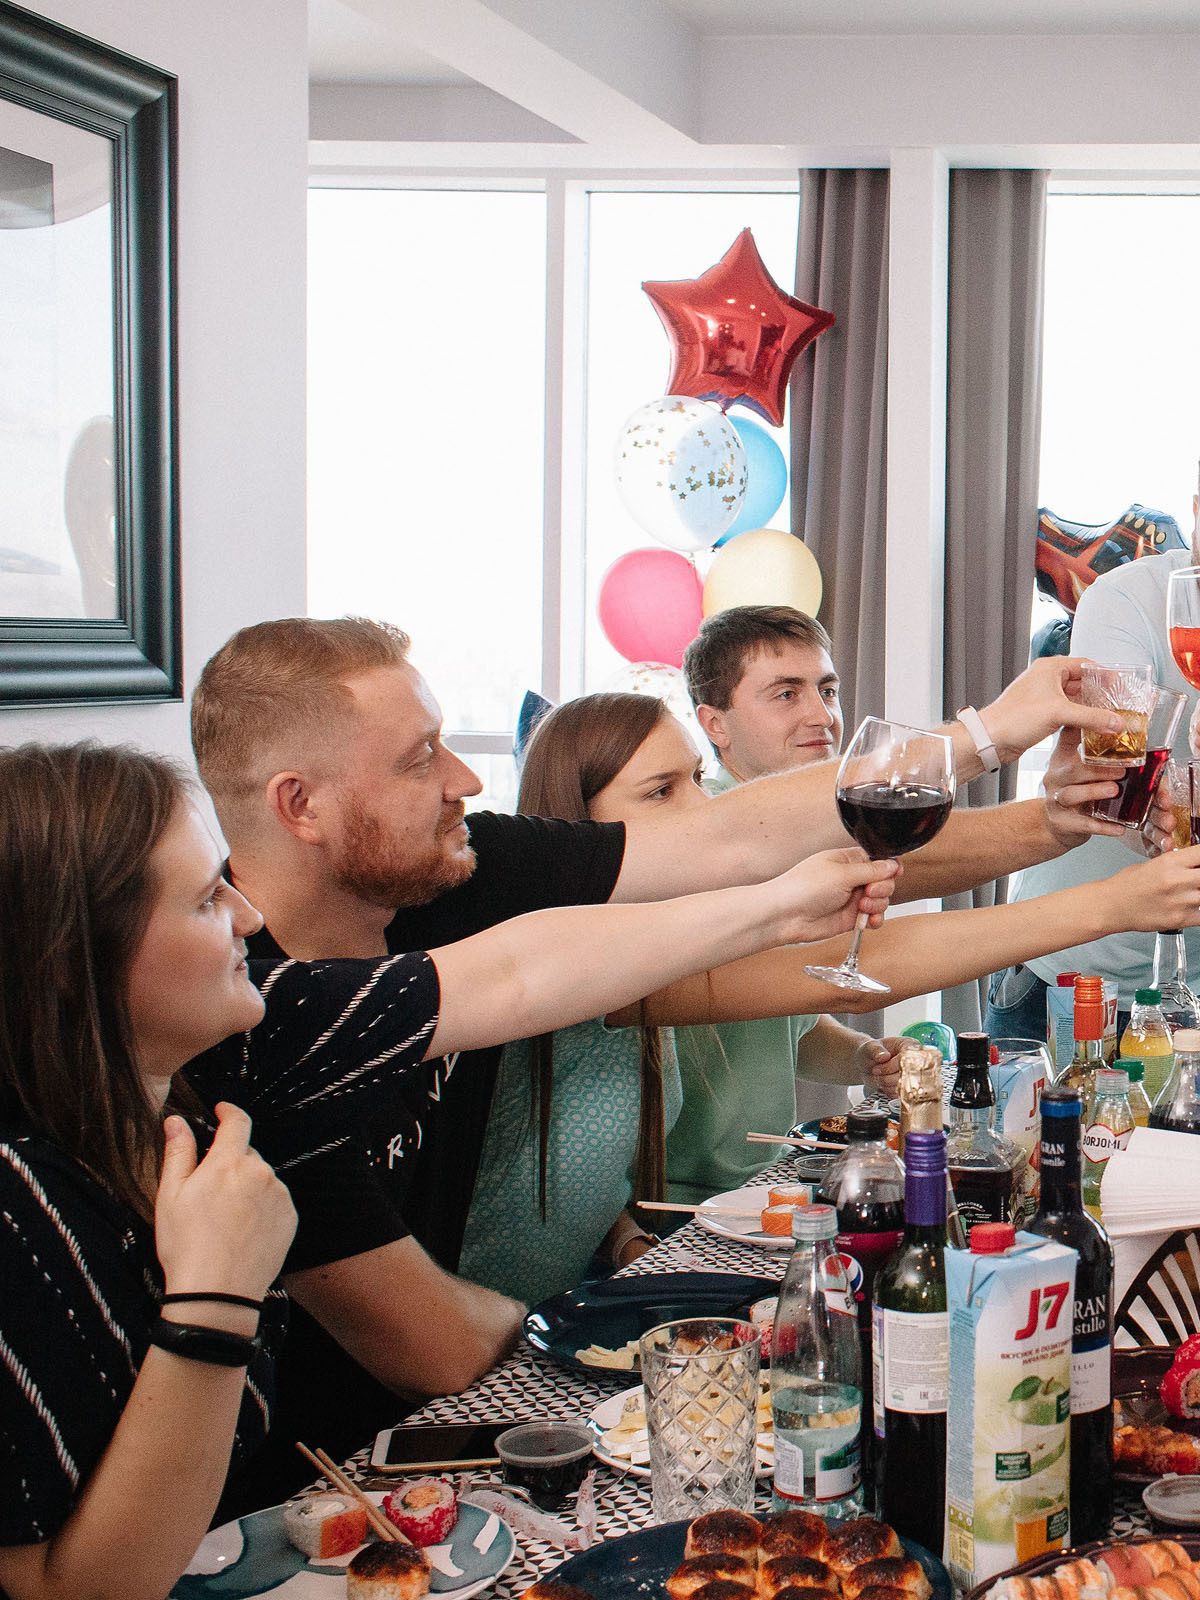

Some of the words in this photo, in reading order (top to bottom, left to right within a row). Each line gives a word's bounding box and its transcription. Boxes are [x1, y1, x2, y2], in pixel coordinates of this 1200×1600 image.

[1083, 1135, 1120, 1150] BORJOMI
[1014, 1281, 1070, 1341] J7
[1073, 1294, 1107, 1320] RAN
[1073, 1317, 1106, 1335] stillo
